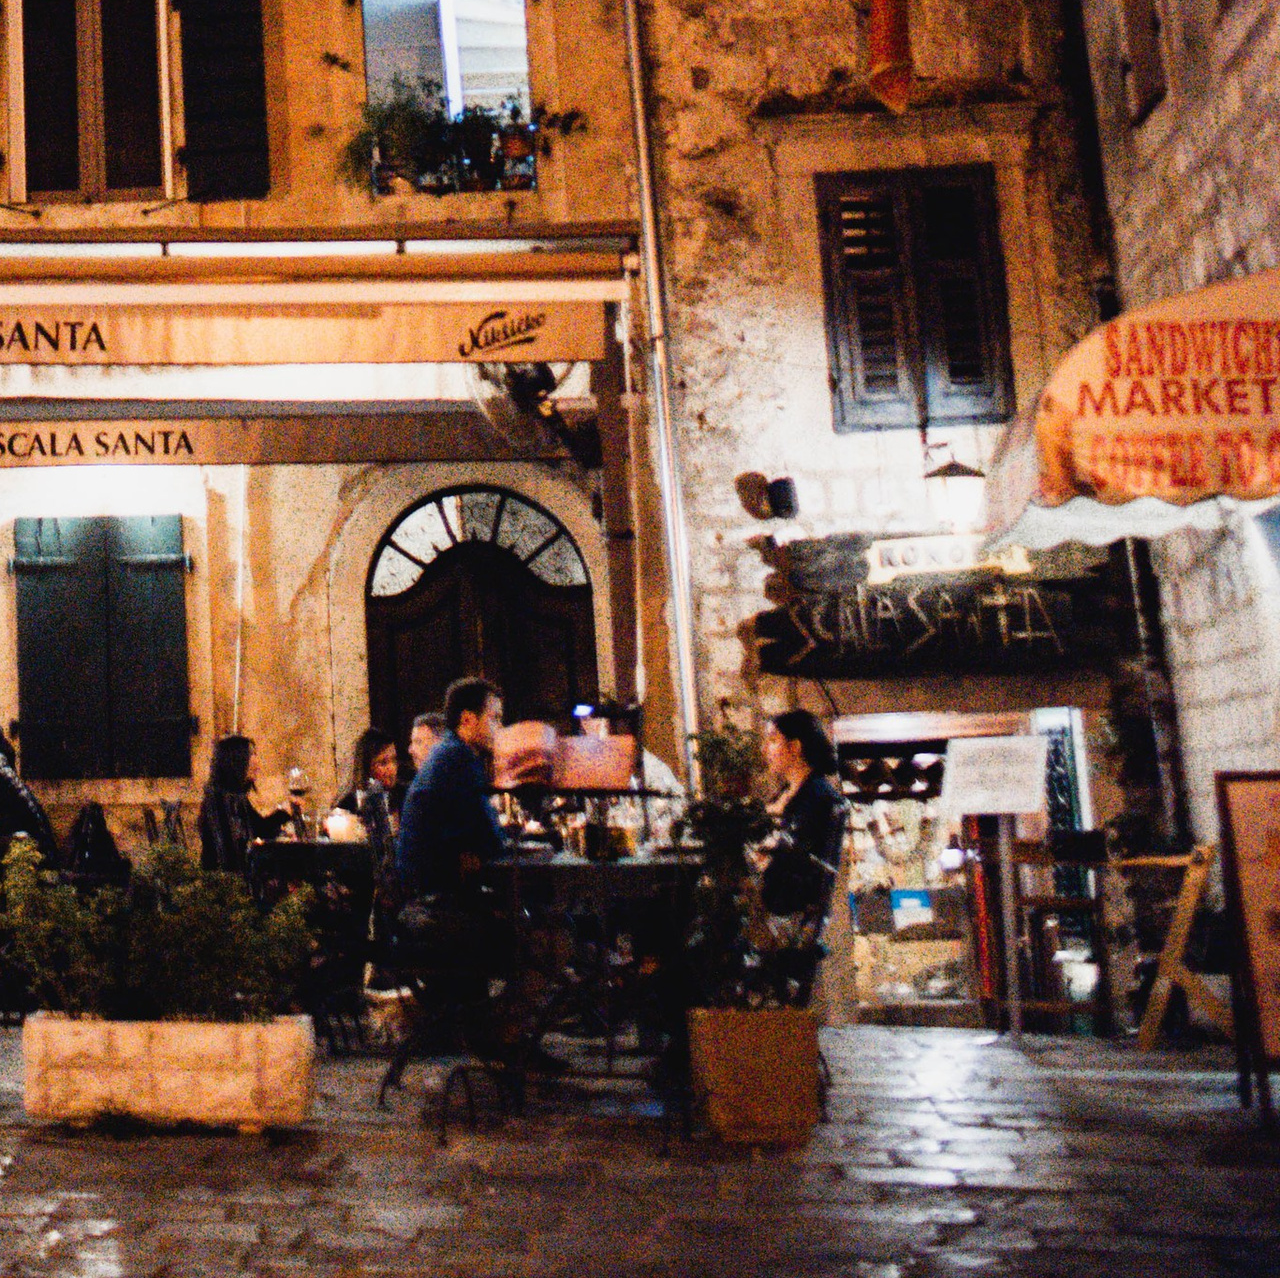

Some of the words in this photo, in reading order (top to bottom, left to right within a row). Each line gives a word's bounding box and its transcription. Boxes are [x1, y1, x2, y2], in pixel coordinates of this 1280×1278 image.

[1105, 319, 1280, 379] SANDWICH
[1077, 378, 1277, 417] MARKET
[94, 430, 195, 457] SANTA
